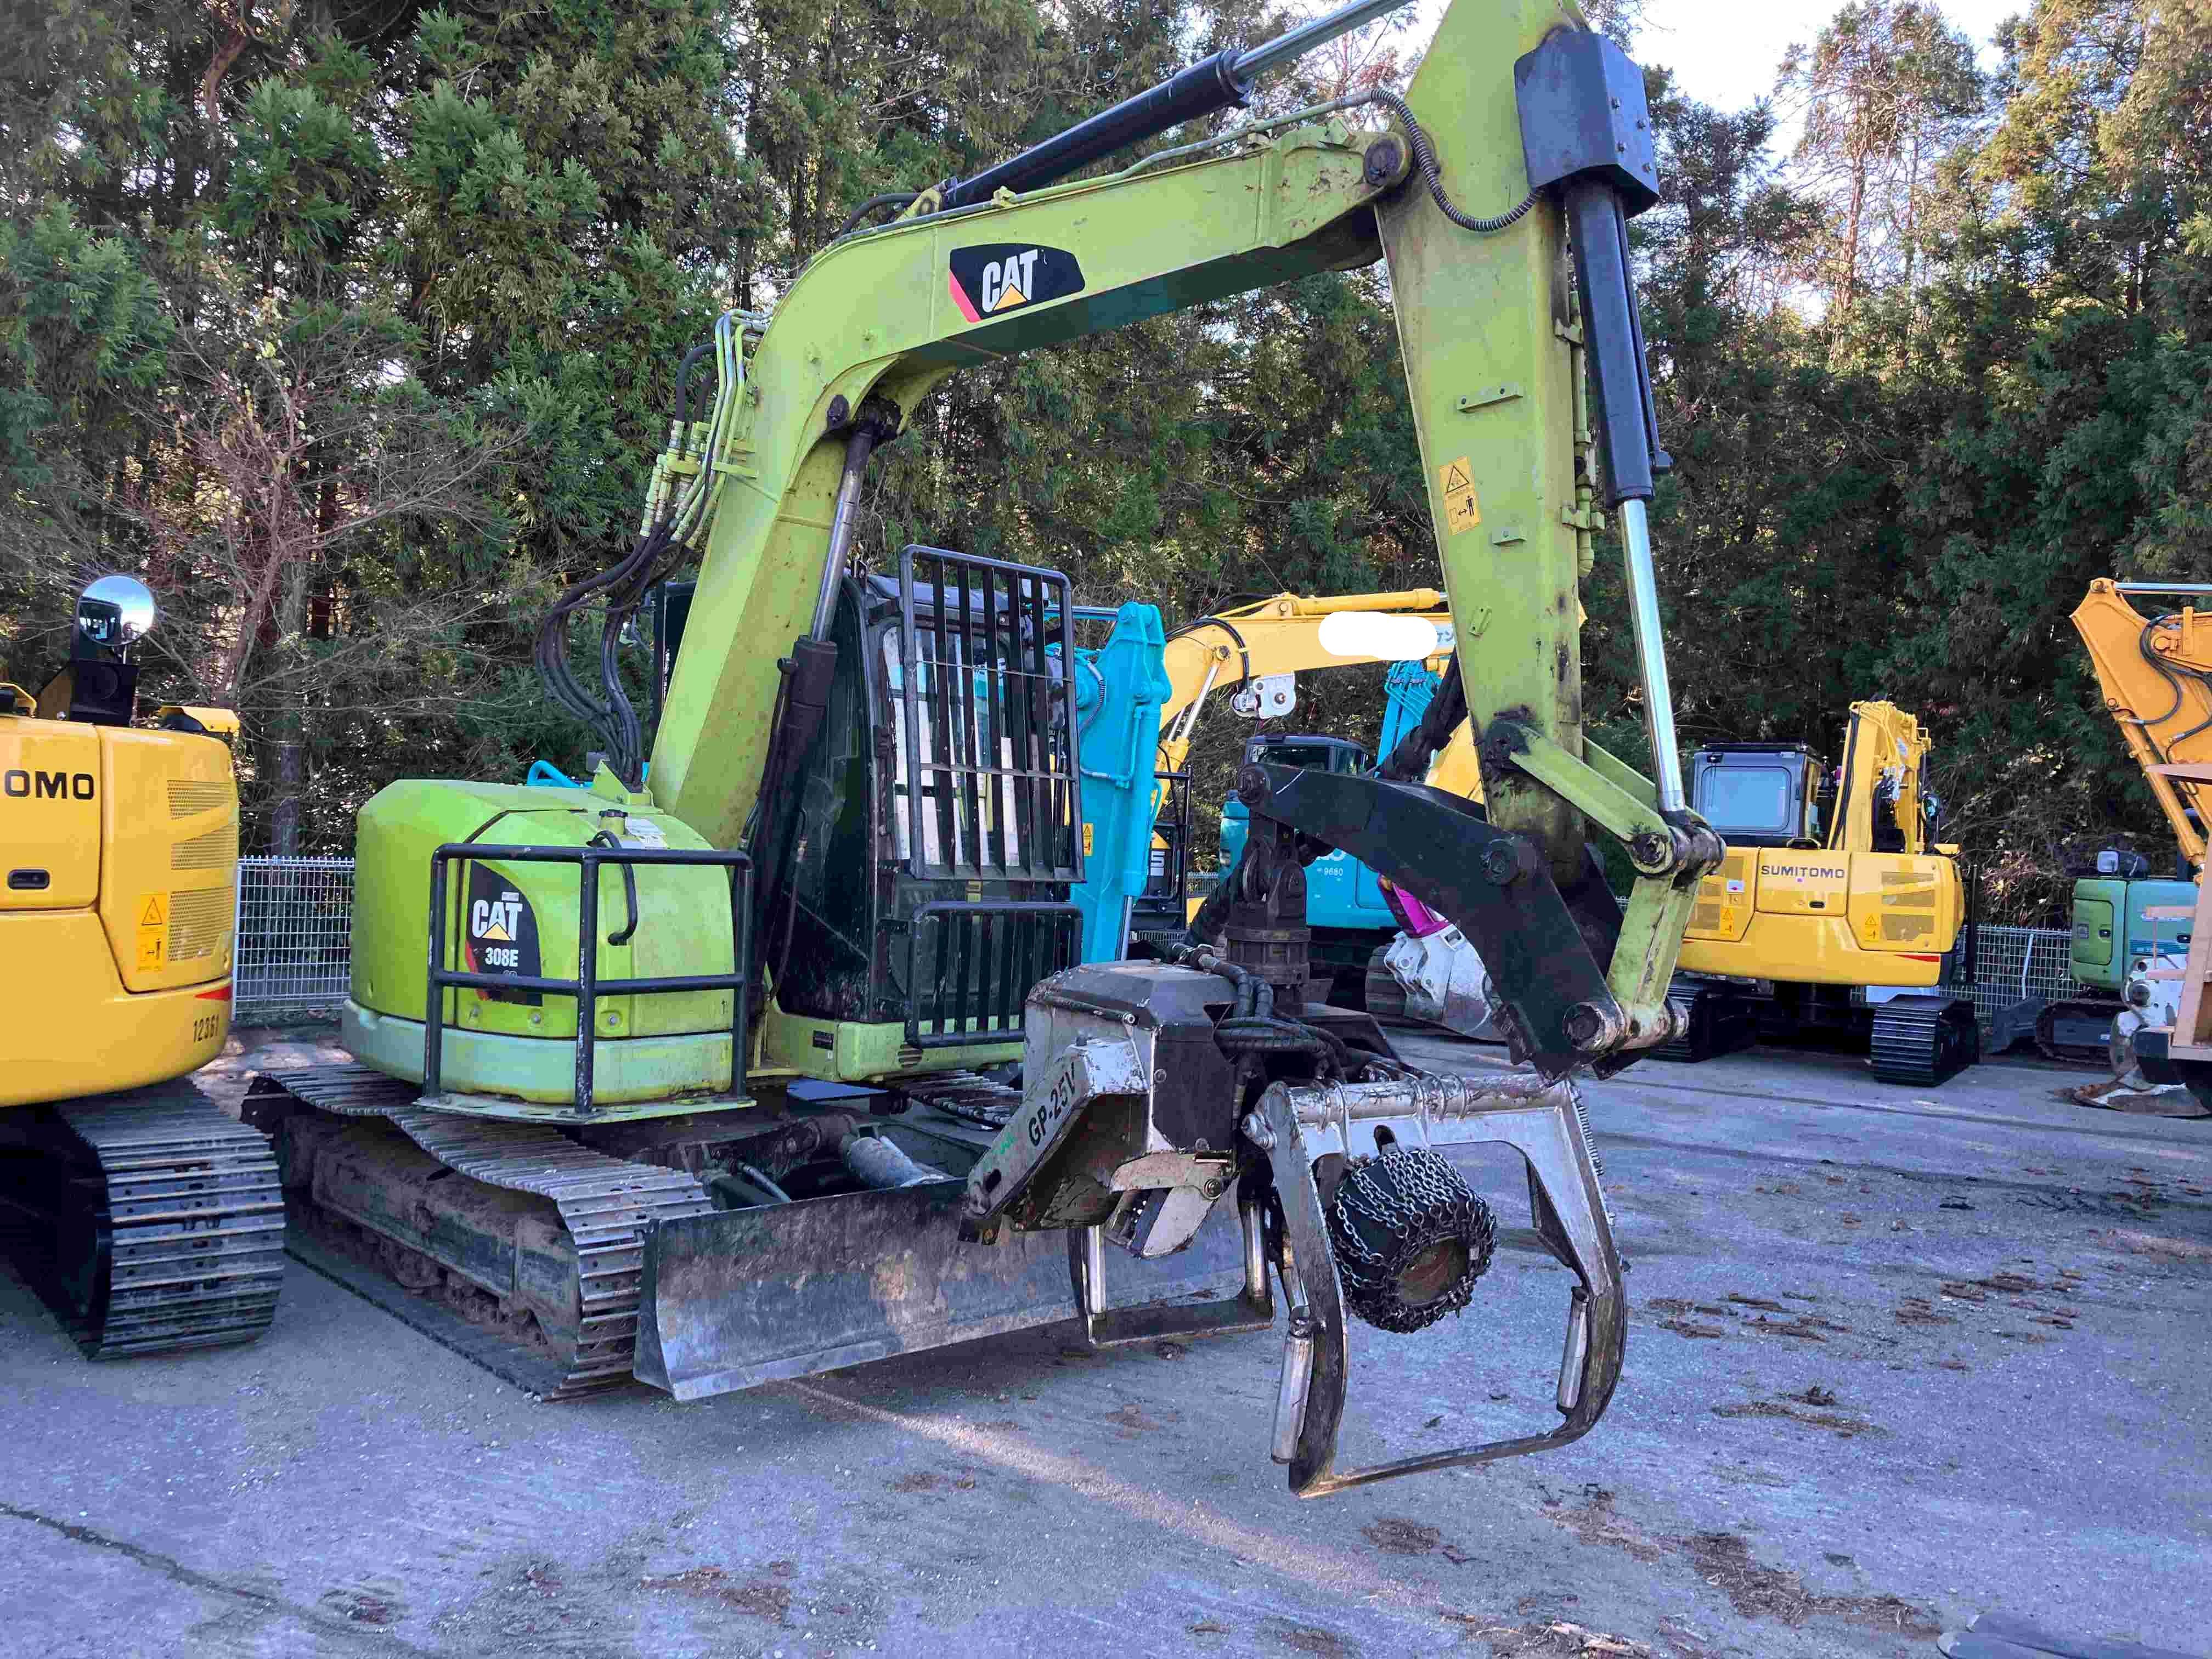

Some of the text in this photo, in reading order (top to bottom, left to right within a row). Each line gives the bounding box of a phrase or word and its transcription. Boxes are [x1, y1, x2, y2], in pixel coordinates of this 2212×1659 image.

[981, 249, 1039, 313] CAT
[5, 769, 94, 800] OMO
[1760, 865, 1844, 878] SUMITOMO
[472, 899, 523, 941] CAT
[484, 947, 518, 967] 308E
